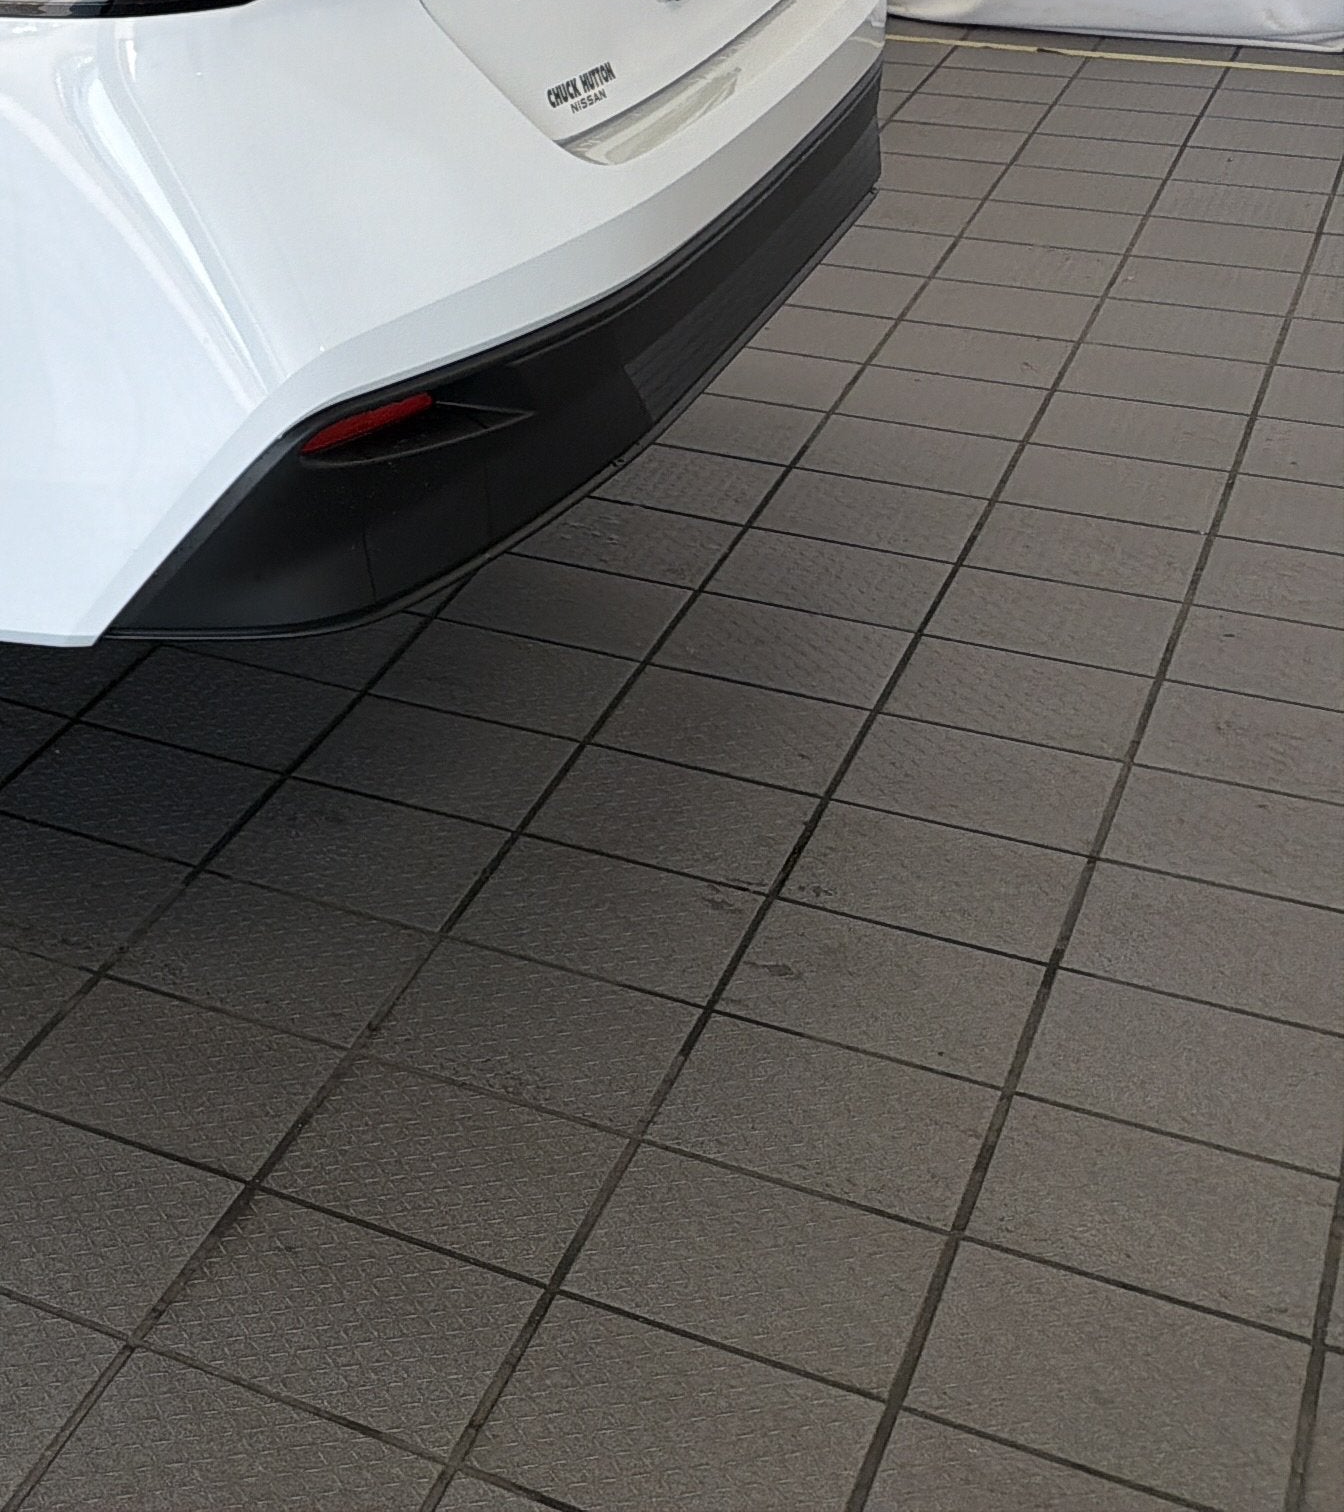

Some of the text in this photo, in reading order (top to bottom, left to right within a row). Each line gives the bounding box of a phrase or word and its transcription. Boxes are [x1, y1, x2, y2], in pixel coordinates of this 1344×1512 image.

[547, 61, 616, 108] CHUCK HUTTON
[570, 88, 607, 114] NISSAN
